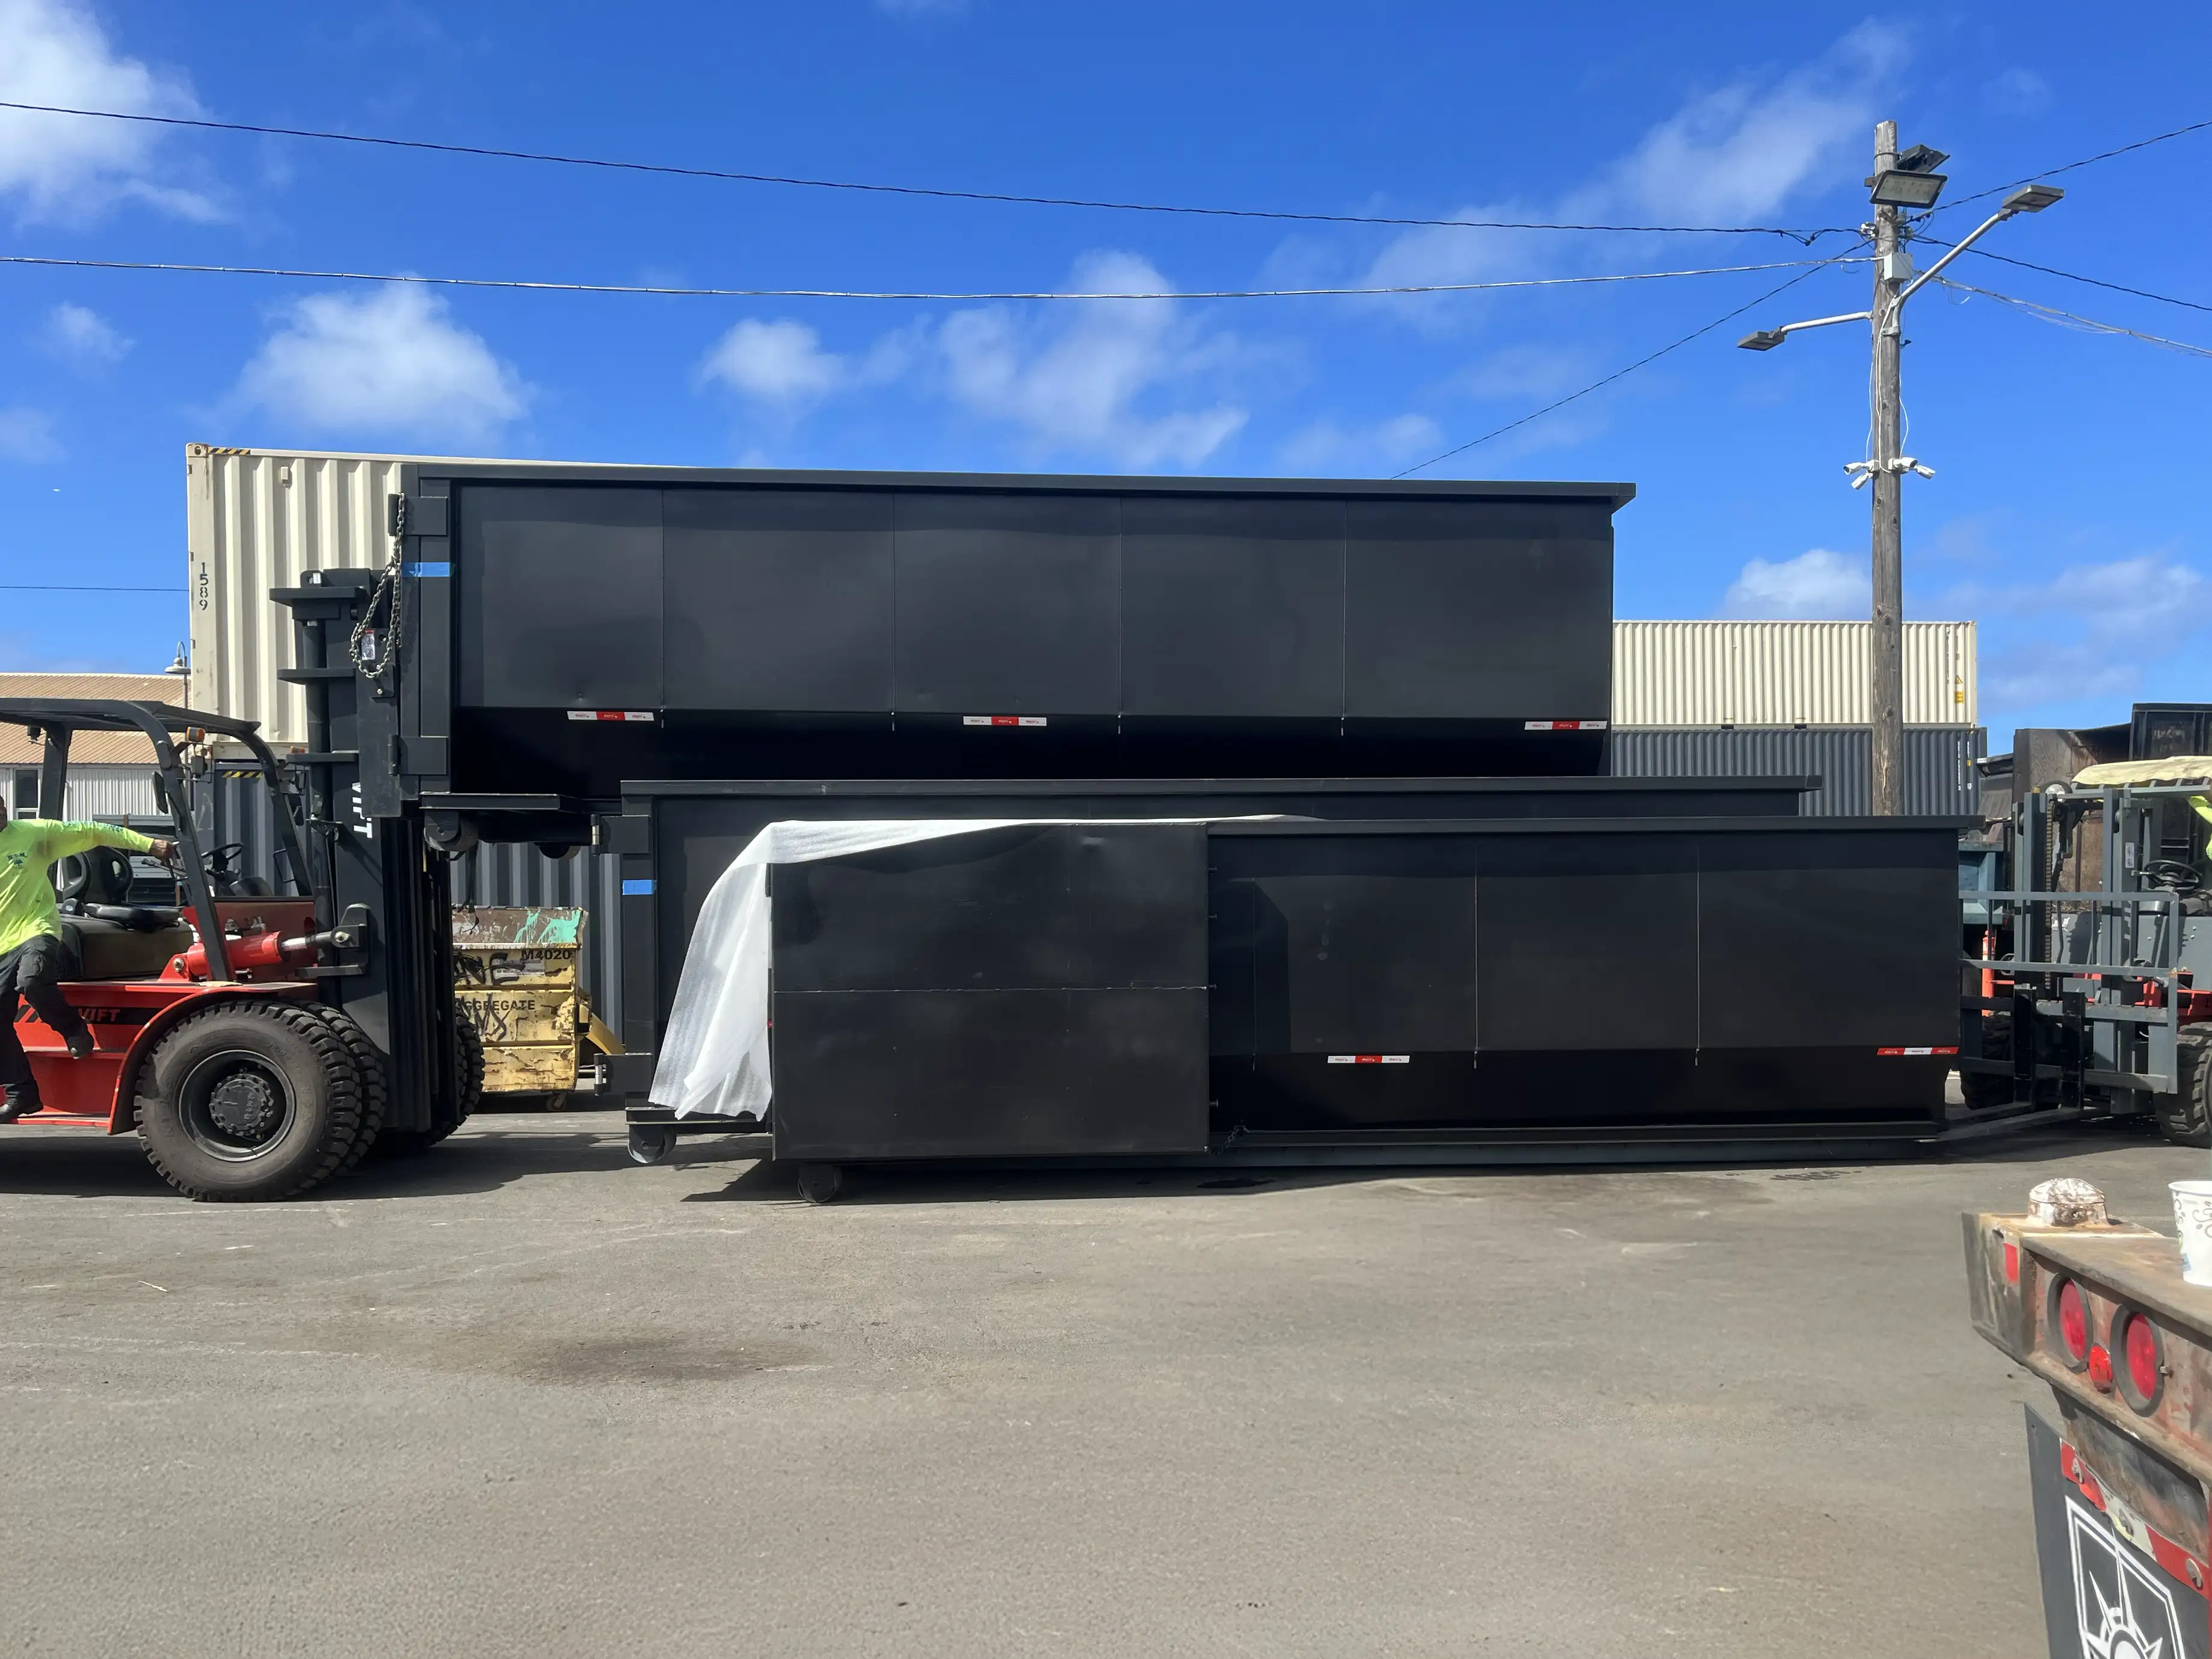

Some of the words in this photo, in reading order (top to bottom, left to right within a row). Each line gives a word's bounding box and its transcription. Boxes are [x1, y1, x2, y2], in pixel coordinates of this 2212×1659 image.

[199, 561, 209, 611] 1589
[520, 950, 571, 960] M4020
[455, 999, 535, 1011] GGREGATE
